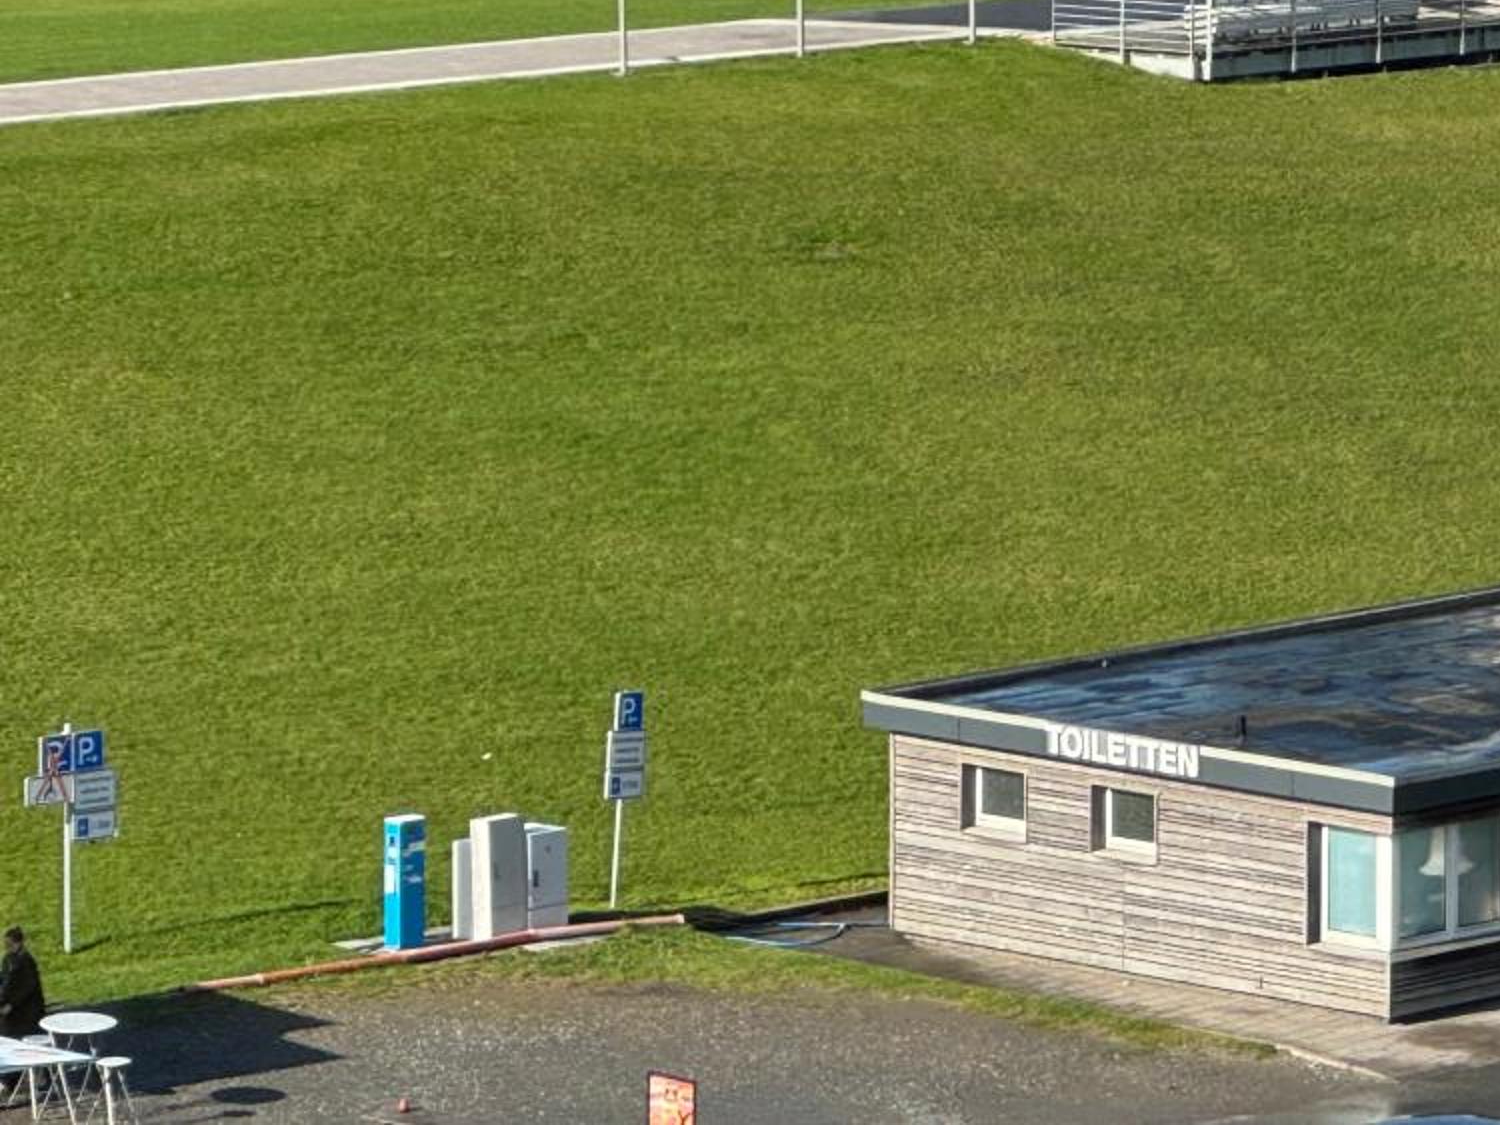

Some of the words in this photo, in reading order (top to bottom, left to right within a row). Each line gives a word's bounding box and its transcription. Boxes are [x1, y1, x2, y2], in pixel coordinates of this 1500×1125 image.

[621, 698, 636, 725] P
[78, 736, 95, 765] P
[1047, 725, 1200, 778] TOILETTEN
